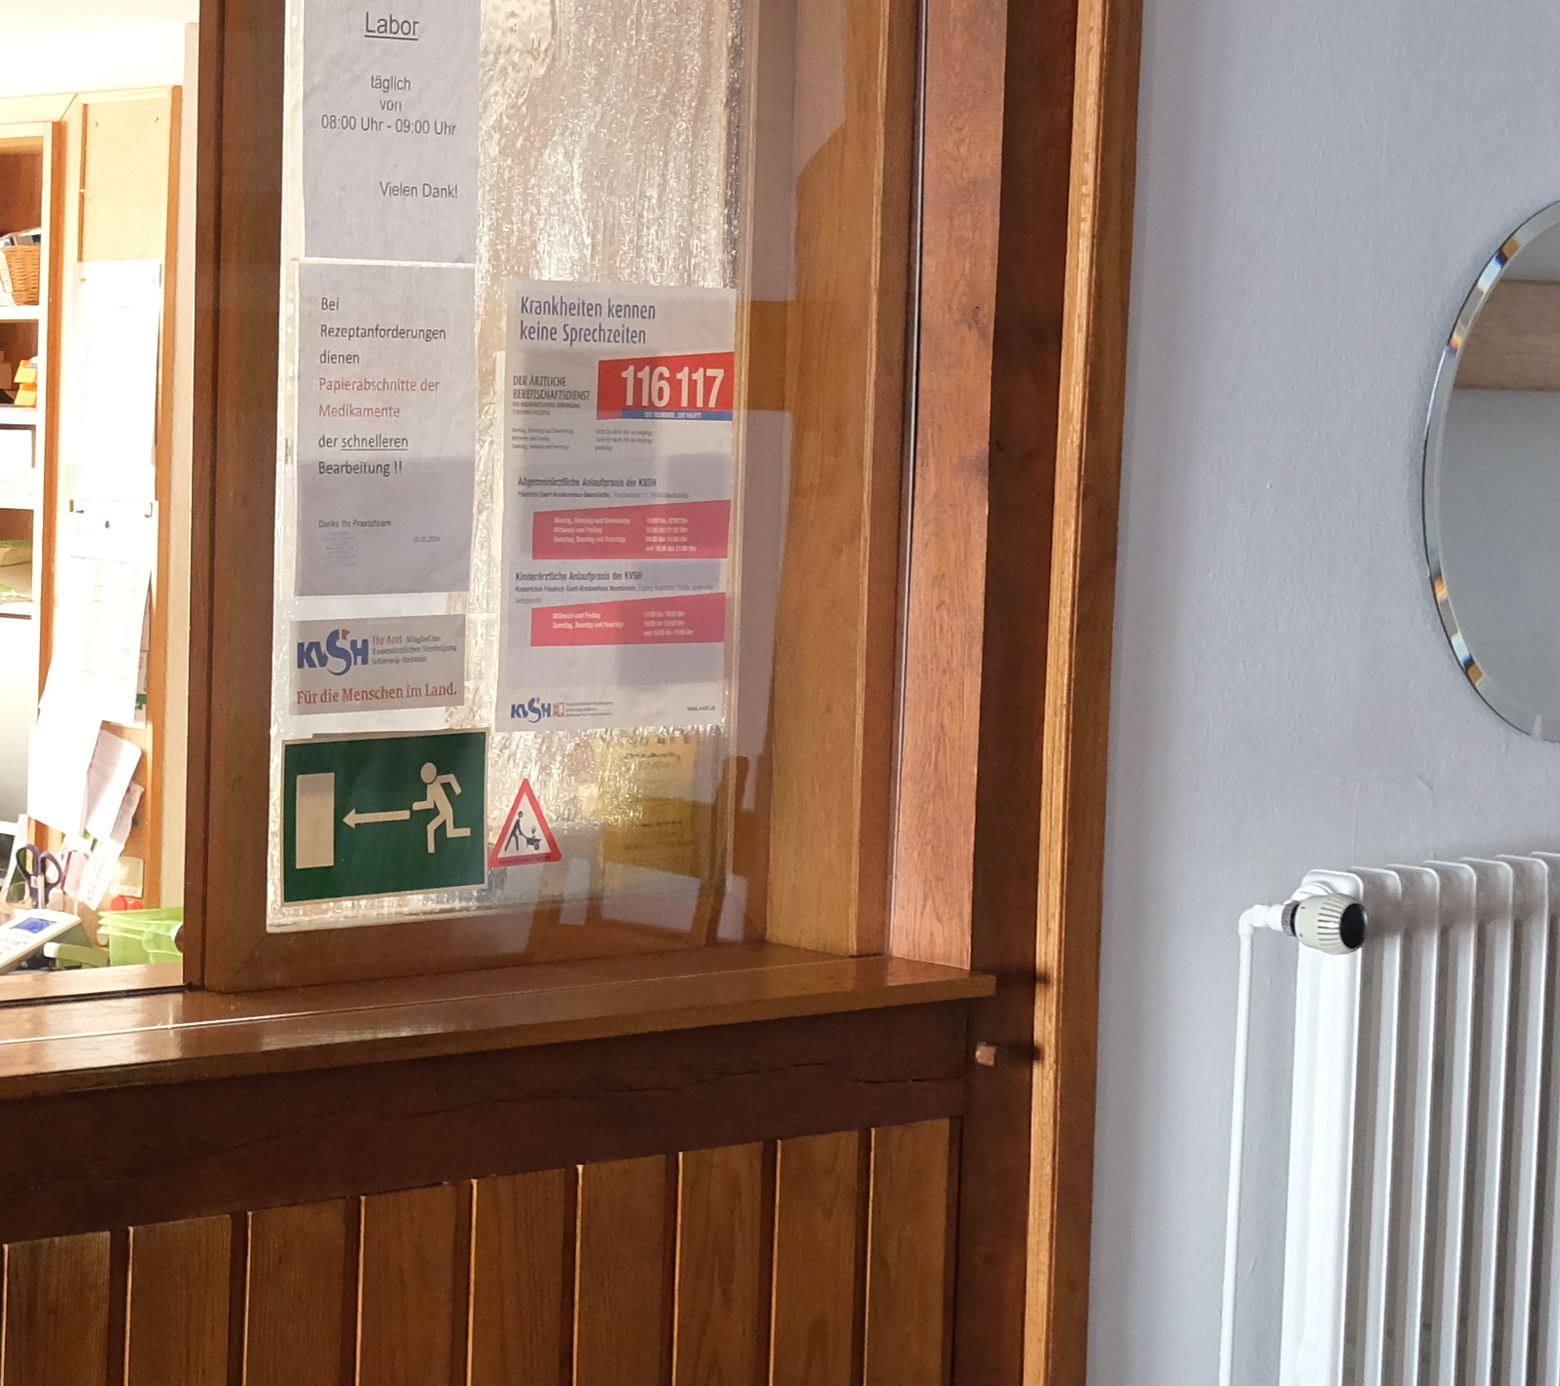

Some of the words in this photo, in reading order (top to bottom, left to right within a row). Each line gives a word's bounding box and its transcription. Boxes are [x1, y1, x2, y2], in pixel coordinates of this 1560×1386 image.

[365, 11, 420, 36] Labor
[371, 75, 411, 94] täglich
[379, 99, 402, 112] von
[321, 114, 357, 132] 08:00
[361, 117, 383, 133] Uhr
[395, 117, 430, 134] 09:00
[434, 120, 457, 136] Uhr
[379, 180, 418, 199] Vielen
[422, 182, 459, 200] Dank!
[321, 297, 339, 311] Bei
[520, 295, 602, 318] Krankheiten
[607, 298, 656, 320] kennen
[320, 324, 447, 343] Rezeptanforderungen
[520, 319, 558, 342] keine
[562, 323, 647, 346] Sprechzeiten
[319, 350, 360, 365] dienen
[319, 377, 417, 394] Papierabschnitte
[420, 378, 440, 393] der
[318, 404, 400, 419] Medikamente
[318, 434, 339, 449] der
[341, 434, 409, 449] schnelleren
[318, 460, 391, 478] Bearbeitung
[297, 629, 369, 677] KVSH
[297, 690, 317, 705] Für
[319, 688, 339, 704] die
[341, 685, 403, 703] Menschen
[406, 683, 422, 699] im
[424, 680, 457, 698] Land.
